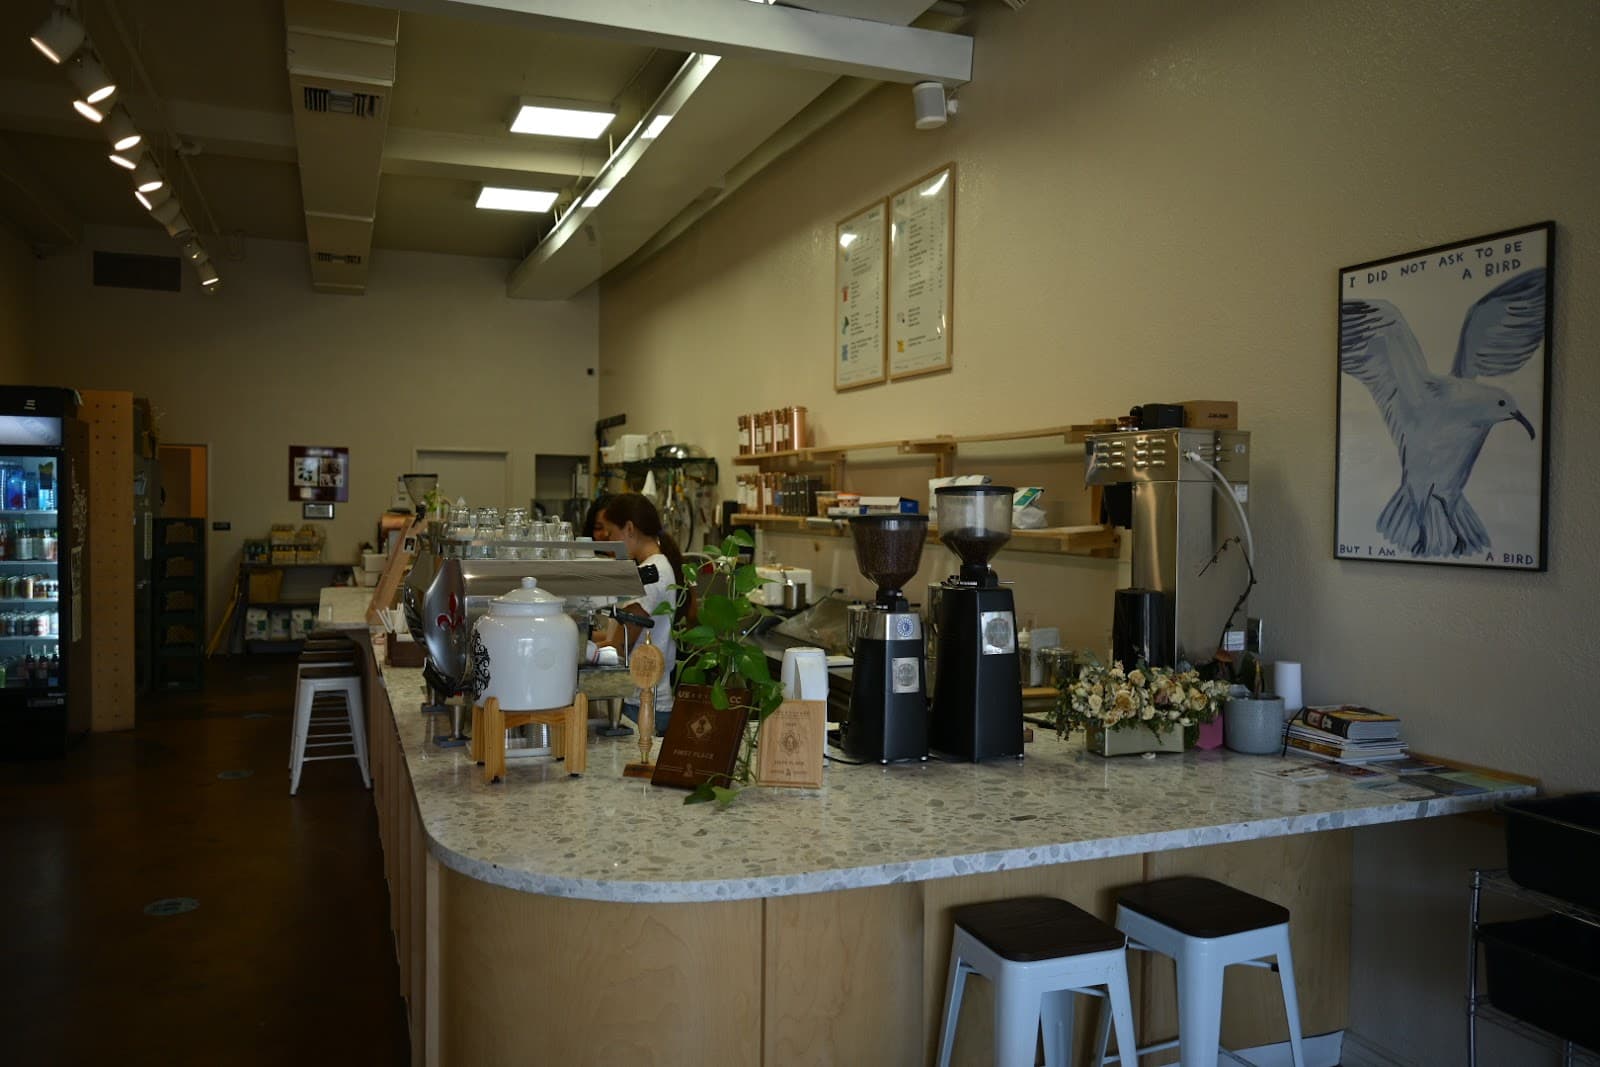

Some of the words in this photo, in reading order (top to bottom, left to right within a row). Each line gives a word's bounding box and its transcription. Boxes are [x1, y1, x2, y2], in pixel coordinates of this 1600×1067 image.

[1350, 276, 1356, 288] I
[1367, 270, 1388, 284] DID
[1400, 260, 1427, 276] NOT
[1438, 252, 1464, 268] ASK
[1476, 247, 1494, 259] TO
[1504, 241, 1522, 254] BE
[1462, 268, 1472, 280] A
[1485, 258, 1521, 277] BIRD
[1339, 544, 1360, 554] BUT
[1368, 546, 1372, 555] I
[1378, 547, 1396, 557] AM
[1485, 552, 1494, 561] A
[1503, 554, 1534, 565] BIRD
